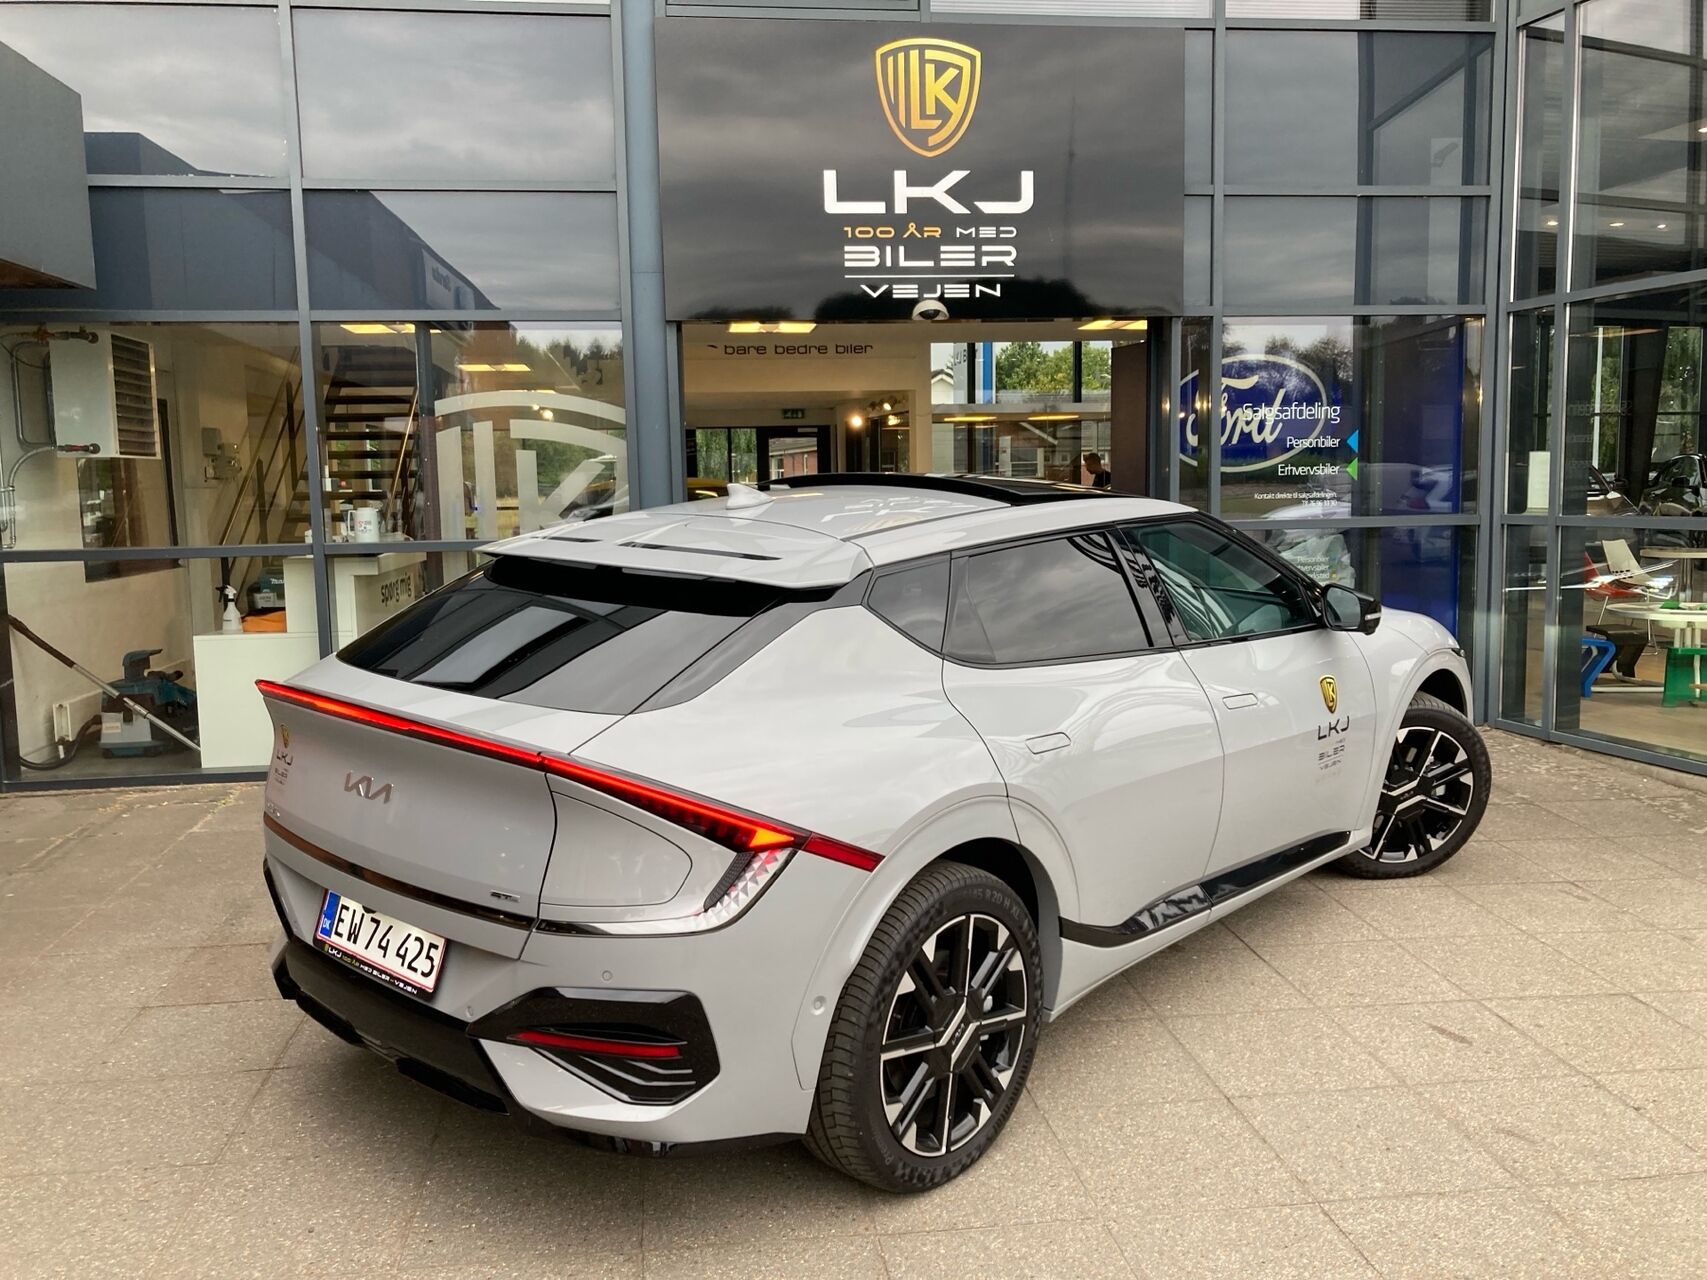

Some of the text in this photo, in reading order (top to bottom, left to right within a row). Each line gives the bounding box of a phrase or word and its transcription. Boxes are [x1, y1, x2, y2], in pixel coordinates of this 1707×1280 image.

[823, 169, 1034, 214] LKJ
[843, 222, 1017, 238] 100 ÅR MED
[844, 245, 1017, 267] BILER
[860, 284, 1001, 298] VEJEN
[724, 343, 873, 355] bare bedre biler
[1243, 402, 1341, 424] Salgsafdeling
[1286, 436, 1341, 448] Personbiler
[1278, 464, 1340, 476] Erhvervsbiler
[1317, 715, 1350, 741] LKJ
[344, 770, 394, 804] KIA
[334, 903, 365, 944] EW
[364, 916, 393, 959] 74
[396, 933, 439, 978] 425
[328, 946, 342, 958] LKJ
[394, 979, 418, 995] VEJEN
